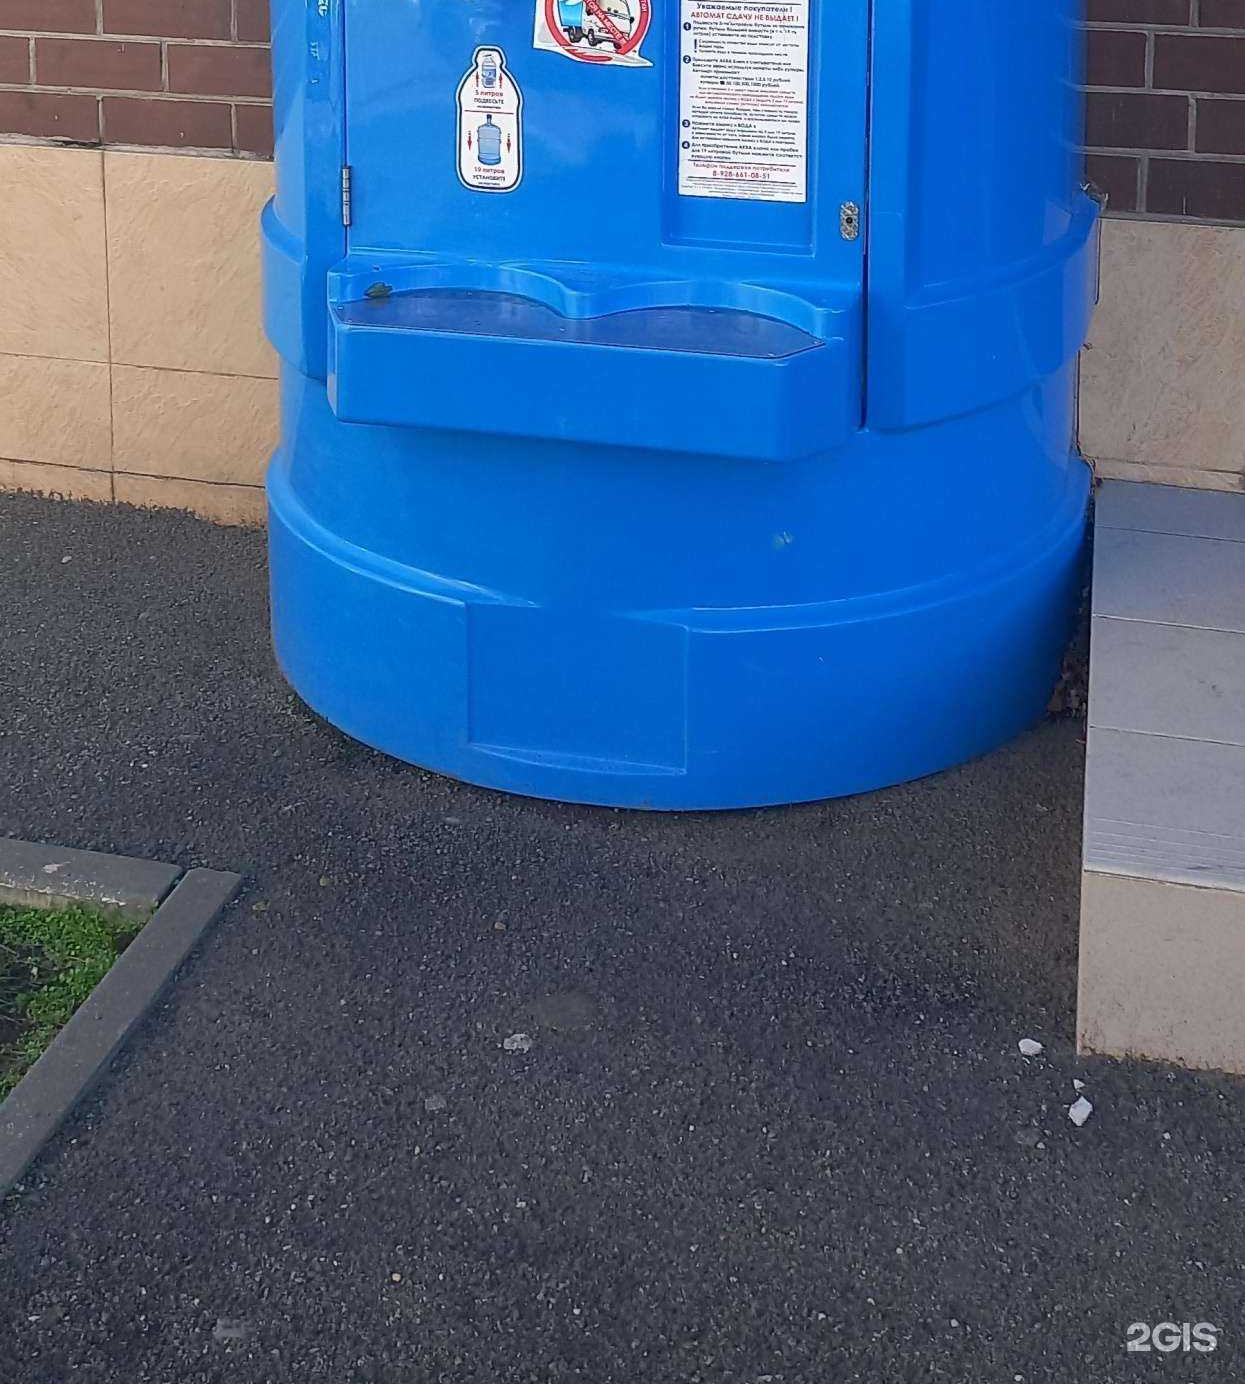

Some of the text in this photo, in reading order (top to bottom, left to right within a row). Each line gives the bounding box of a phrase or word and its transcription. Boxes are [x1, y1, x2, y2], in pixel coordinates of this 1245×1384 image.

[690, 11, 725, 19] АВТОМАТ
[726, 13, 752, 21] СДАЧУ
[712, 170, 770, 179] 8-928-661-08-51
